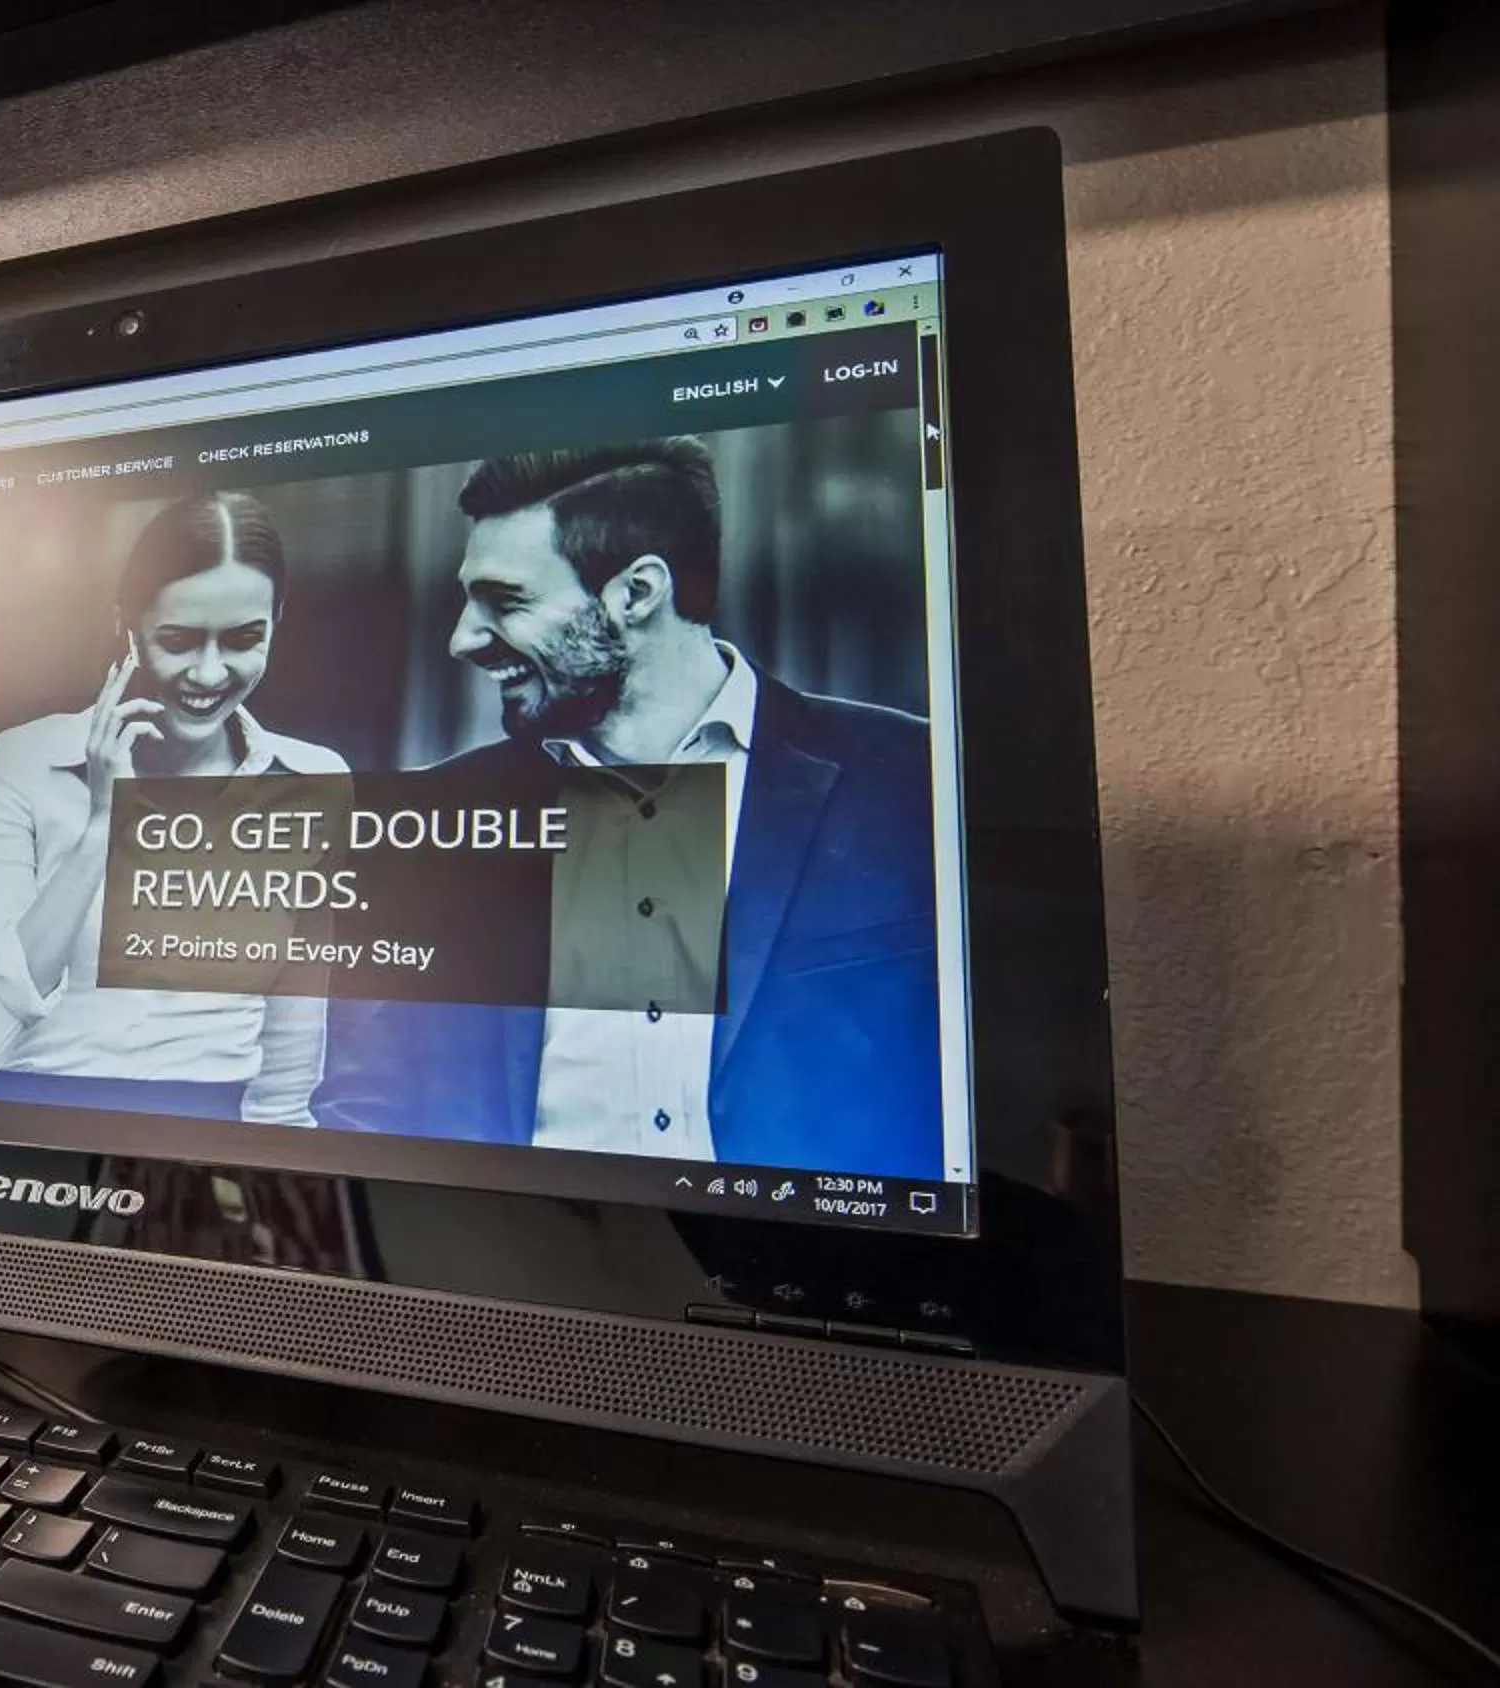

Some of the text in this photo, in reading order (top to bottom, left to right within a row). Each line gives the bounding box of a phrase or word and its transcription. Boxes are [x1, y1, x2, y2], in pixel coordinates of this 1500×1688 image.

[823, 358, 899, 383] LOG-IN
[672, 376, 759, 402] ENGLISH
[198, 430, 370, 463] CHECK RESERVATIONS
[37, 456, 174, 485] CUSTOMER SERVICE
[135, 806, 568, 852] GO. GET. DOUBLE
[131, 869, 370, 911] REWARDS.
[124, 934, 435, 971] 2x Points on Every Stay
[815, 1176, 884, 1196] 12:30 PM
[813, 1197, 887, 1217] 10/8/2017
[318, 1475, 370, 1494] Pause
[401, 1489, 448, 1508] Insert
[291, 1528, 338, 1549] Home
[386, 1548, 421, 1564] End
[513, 1568, 567, 1589] NmLk
[125, 1601, 175, 1623] Enter
[250, 1602, 306, 1626] Delete
[365, 1597, 411, 1618] PgUp
[503, 1613, 525, 1632] 7
[615, 1638, 636, 1658] 8
[90, 1656, 137, 1680] Shift
[340, 1653, 389, 1677] PgDn
[736, 1662, 759, 1683] 9
